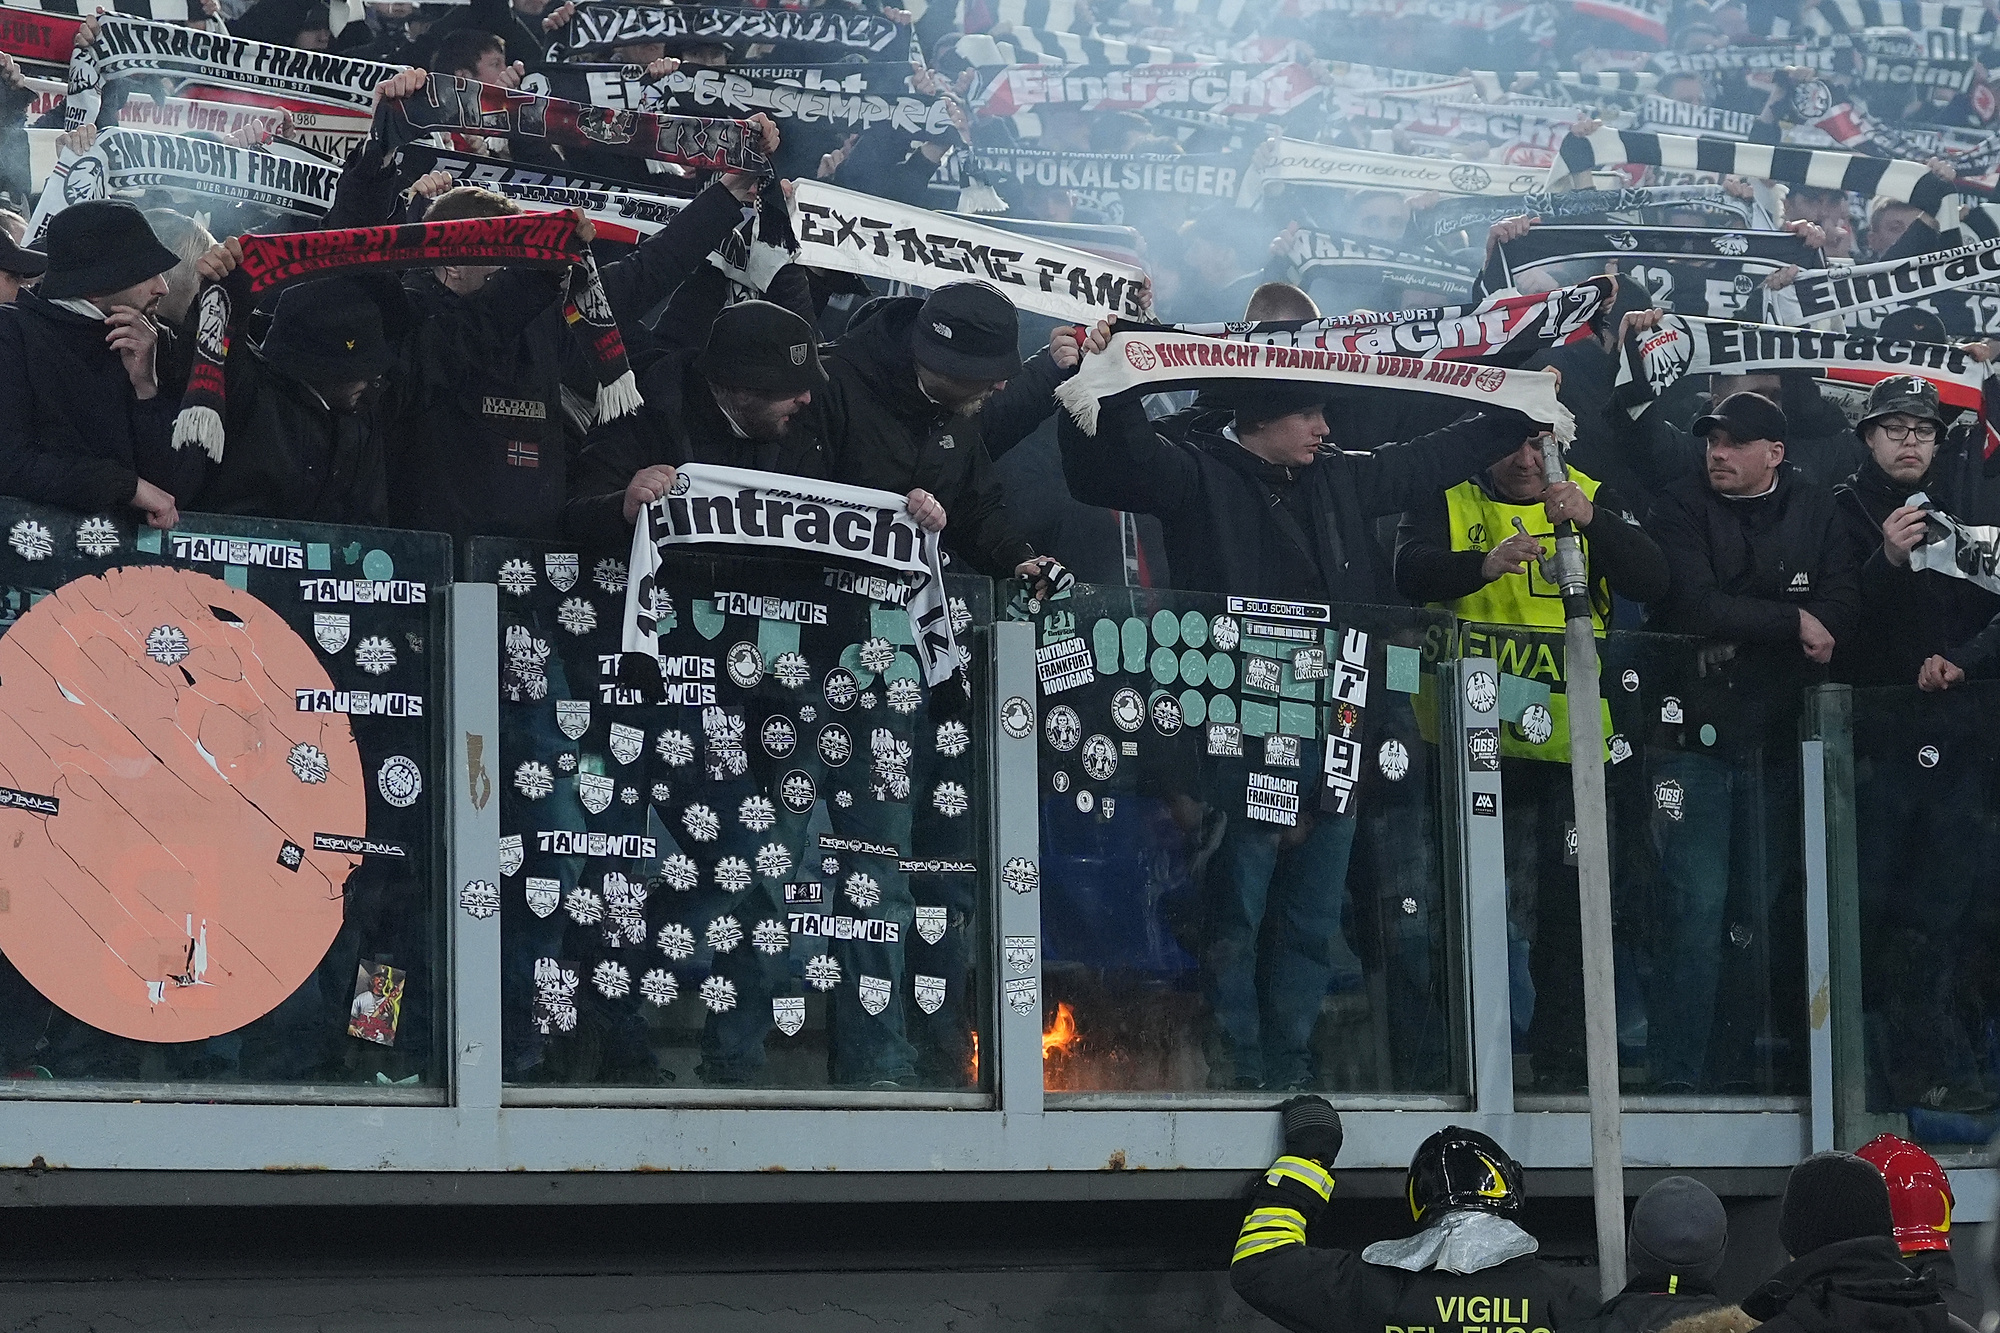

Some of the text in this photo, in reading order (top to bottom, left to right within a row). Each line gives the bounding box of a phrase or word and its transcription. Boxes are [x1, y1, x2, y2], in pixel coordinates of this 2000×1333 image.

[99, 21, 250, 67] EINTRACHT
[200, 66, 312, 93] OVER LAND AND SEA
[106, 137, 241, 181] EINTRACHT
[196, 181, 294, 208] OVER LAND AND SEA
[249, 217, 577, 278] EINTRACHT FRANKFURT
[797, 201, 1144, 318] EXTREME FANS
[1326, 306, 1442, 329] FRANKFURT
[1537, 284, 1603, 338] 12
[1155, 343, 1260, 369] EINTRACHT
[1265, 346, 1372, 375] FRANKFURT
[1424, 361, 1480, 390] ALLES
[1246, 602, 1269, 613] SOLO
[1036, 637, 1087, 663] EINTRACHT
[598, 654, 716, 680] TNUS
[728, 661, 760, 686] FRANKFURT
[1039, 652, 1090, 680] FRANKFURT
[1042, 669, 1095, 696] HOOLIGANS
[1001, 716, 1032, 738] FRANKFURT
[1112, 706, 1140, 729] FRANKFURT
[1473, 738, 1495, 753] 069
[1248, 771, 1299, 795] EINTRACHT
[1659, 787, 1681, 803] 069
[1247, 788, 1298, 811] FRANKFURT
[1246, 804, 1297, 827] HOOLIGANS
[1435, 1296, 1529, 1324] VIGILI
